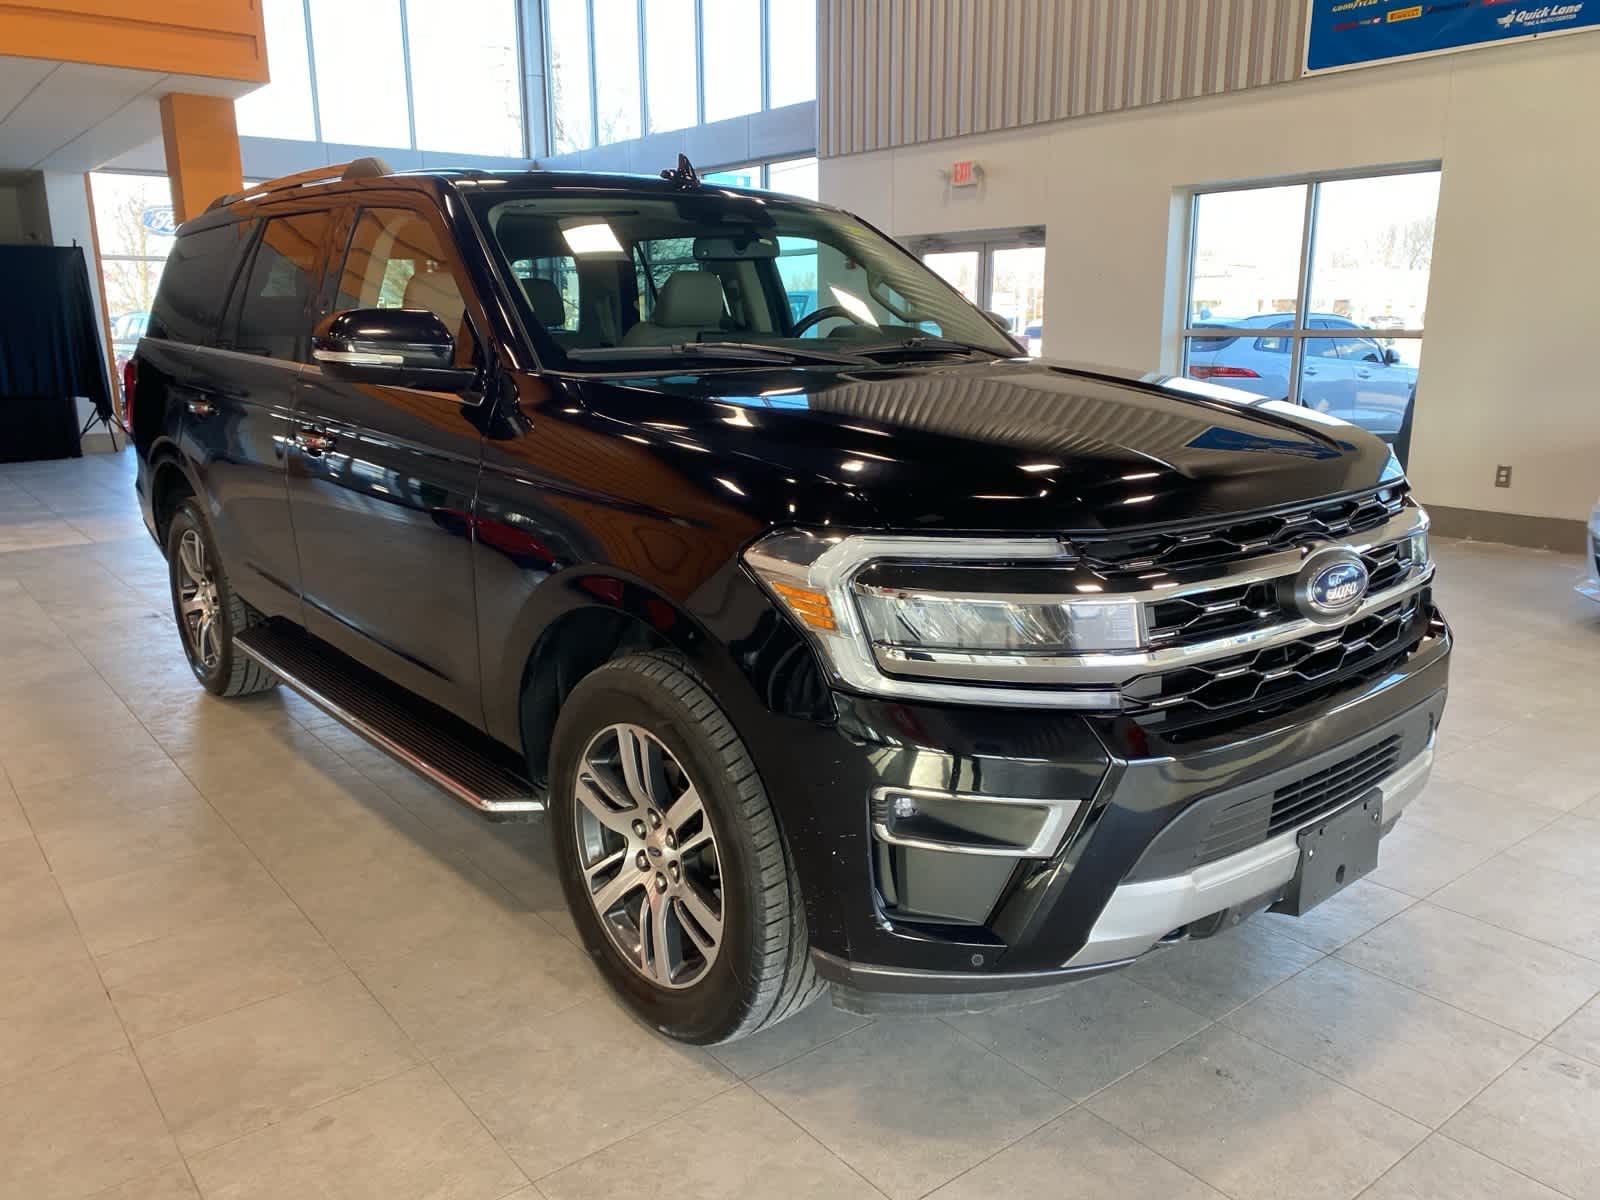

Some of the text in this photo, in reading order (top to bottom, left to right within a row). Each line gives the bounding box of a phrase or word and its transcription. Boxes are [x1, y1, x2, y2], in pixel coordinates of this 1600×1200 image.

[1515, 4, 1582, 23] Quick Lane
[953, 161, 972, 184] EXIT
